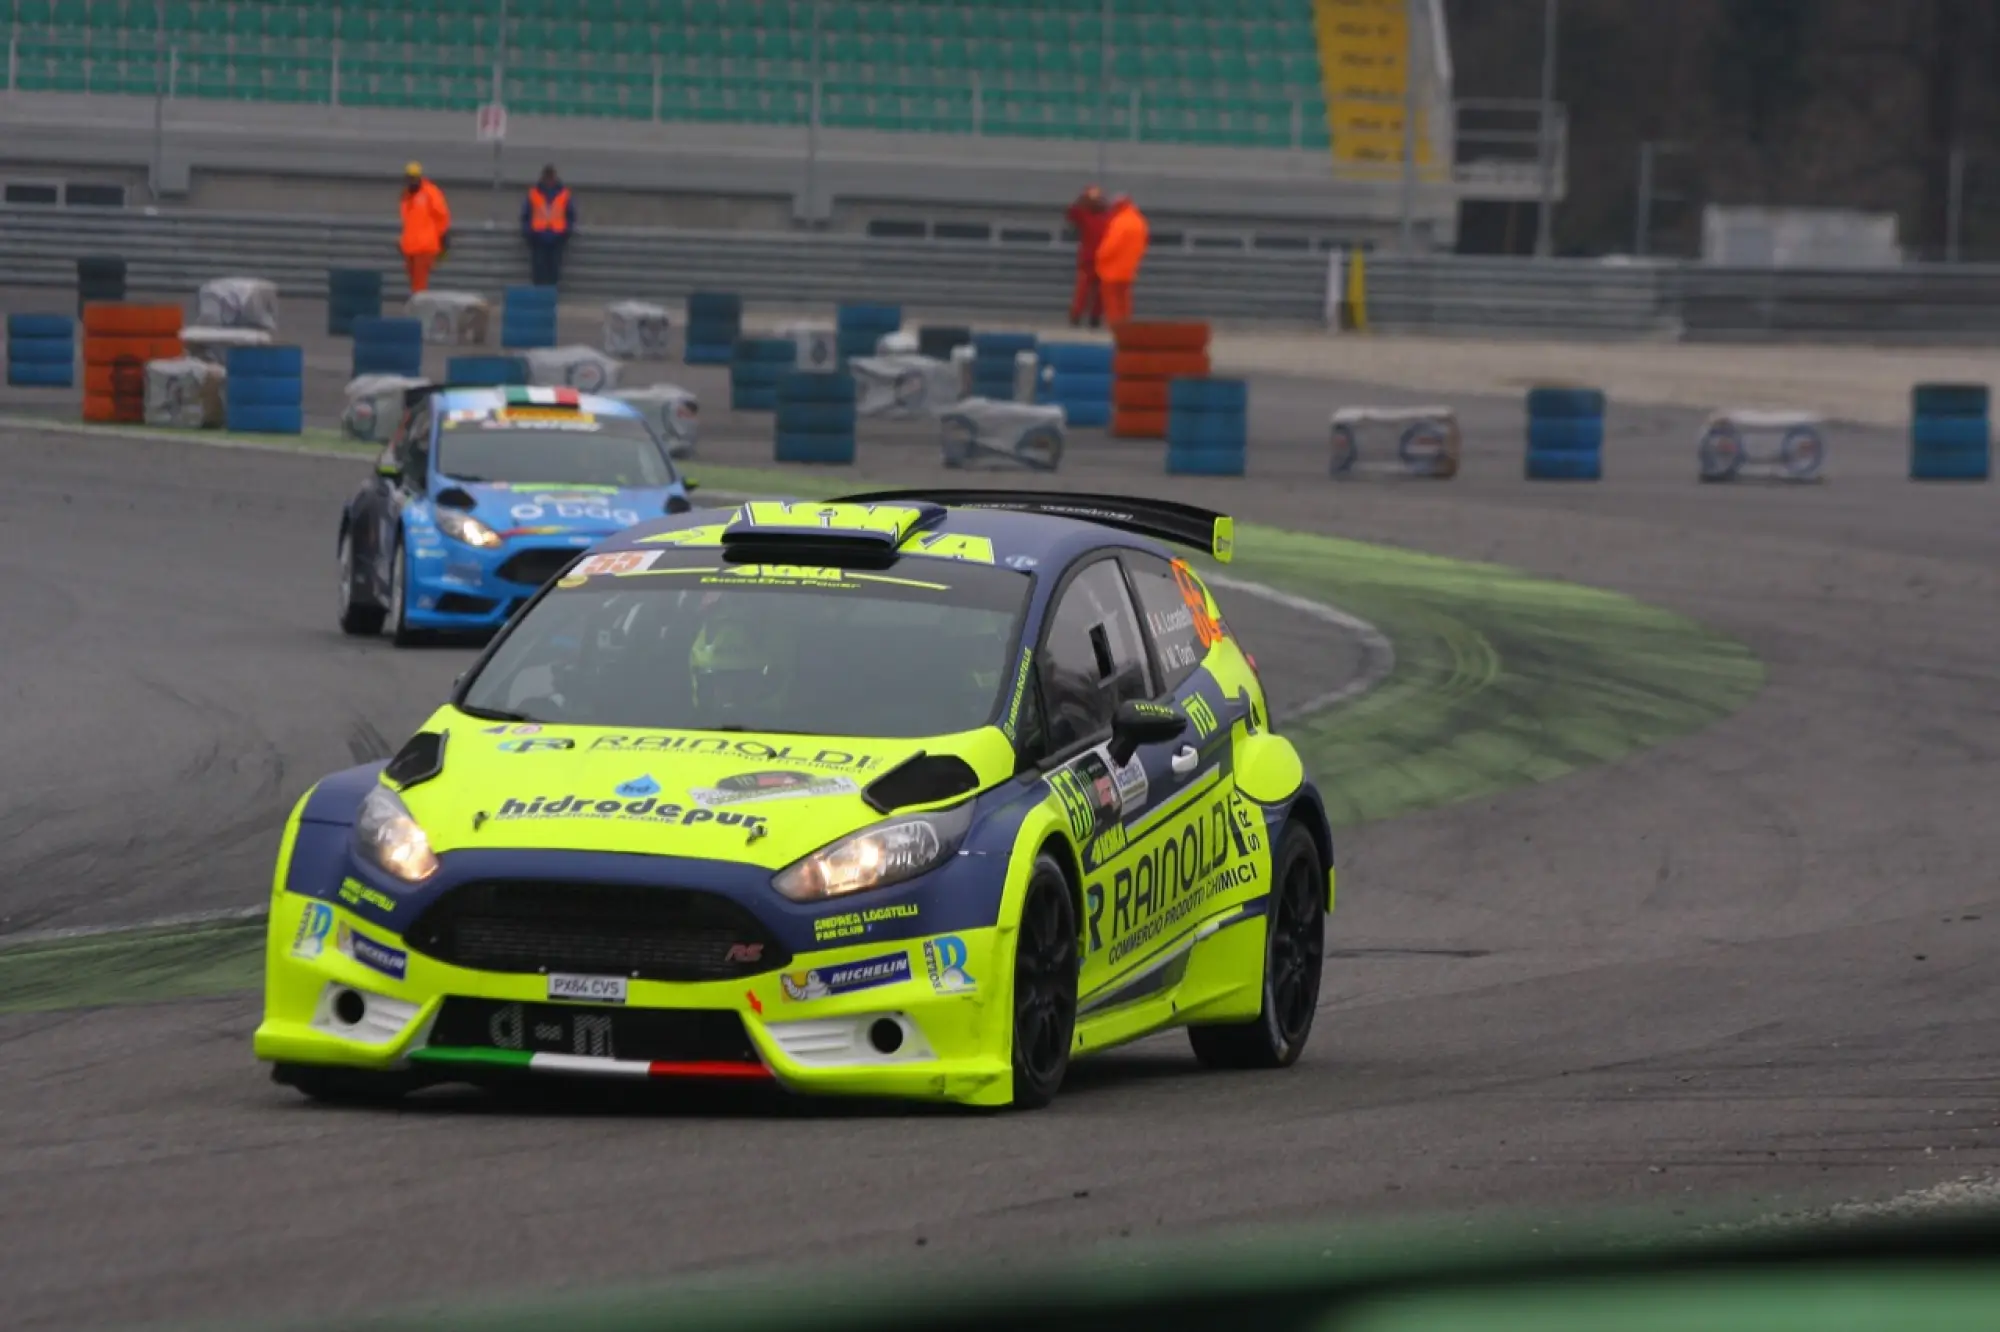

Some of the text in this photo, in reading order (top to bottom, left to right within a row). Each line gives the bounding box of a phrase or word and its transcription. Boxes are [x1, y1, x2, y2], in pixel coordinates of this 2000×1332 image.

[588, 735, 871, 770] RAINOLDI
[500, 795, 767, 829] hidrodepur
[1113, 793, 1251, 942] RAINOLDI
[1205, 861, 1258, 901] CHIMICI
[862, 903, 919, 923] LOCATELLI
[830, 958, 909, 984] MICHELIN
